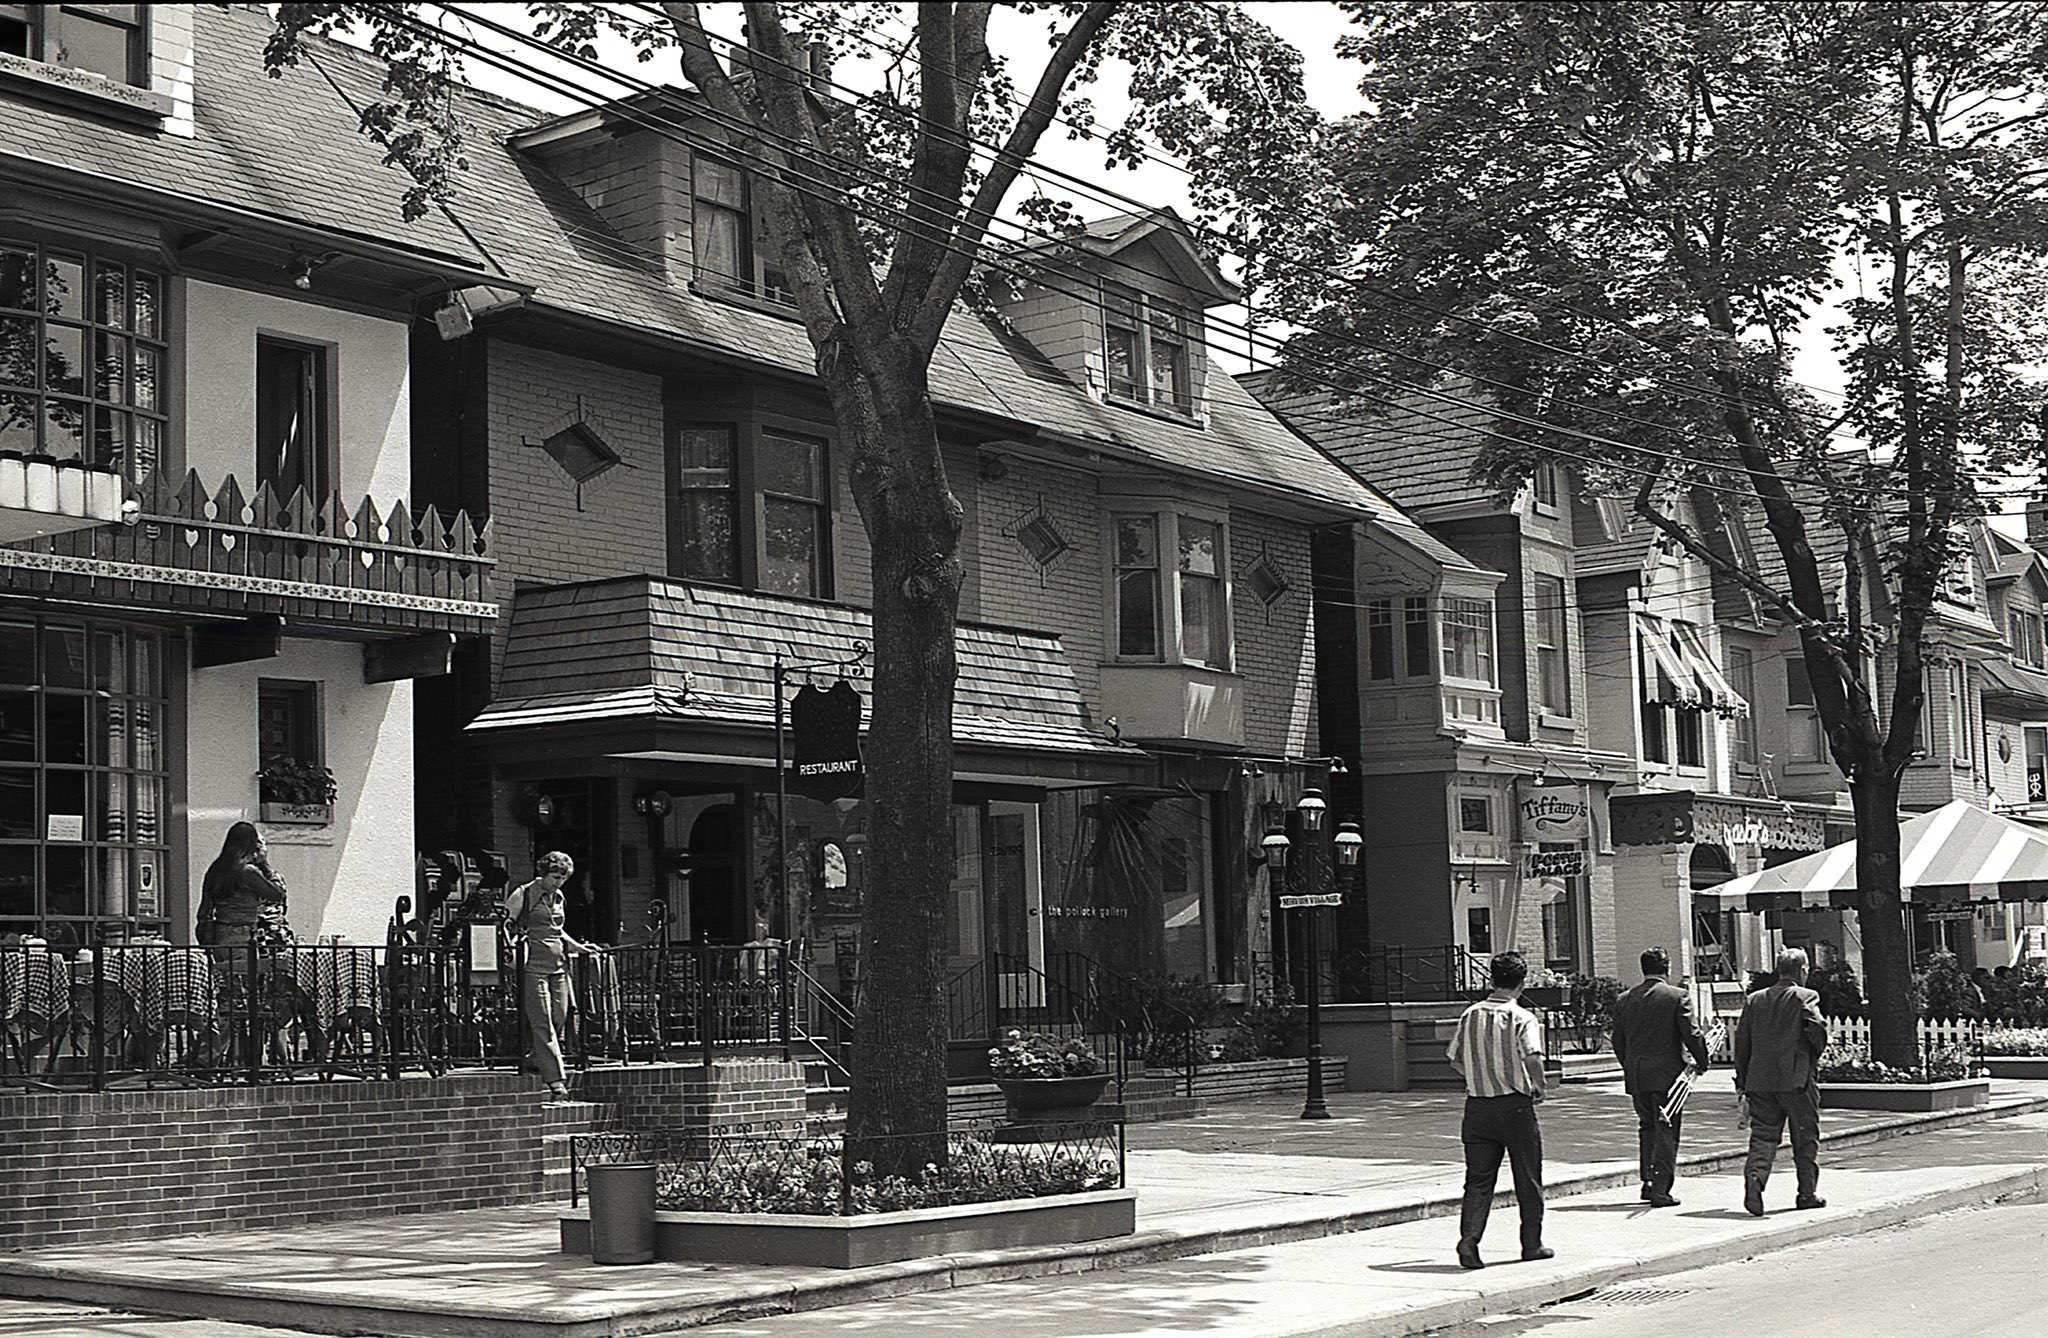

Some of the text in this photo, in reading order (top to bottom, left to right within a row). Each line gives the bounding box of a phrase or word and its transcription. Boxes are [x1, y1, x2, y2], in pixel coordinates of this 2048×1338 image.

[800, 760, 858, 776] RESTAURANT
[1521, 796, 1588, 829] Tiffany's
[1532, 863, 1582, 878] PALACE
[1048, 905, 1128, 918] the pollock gallery
